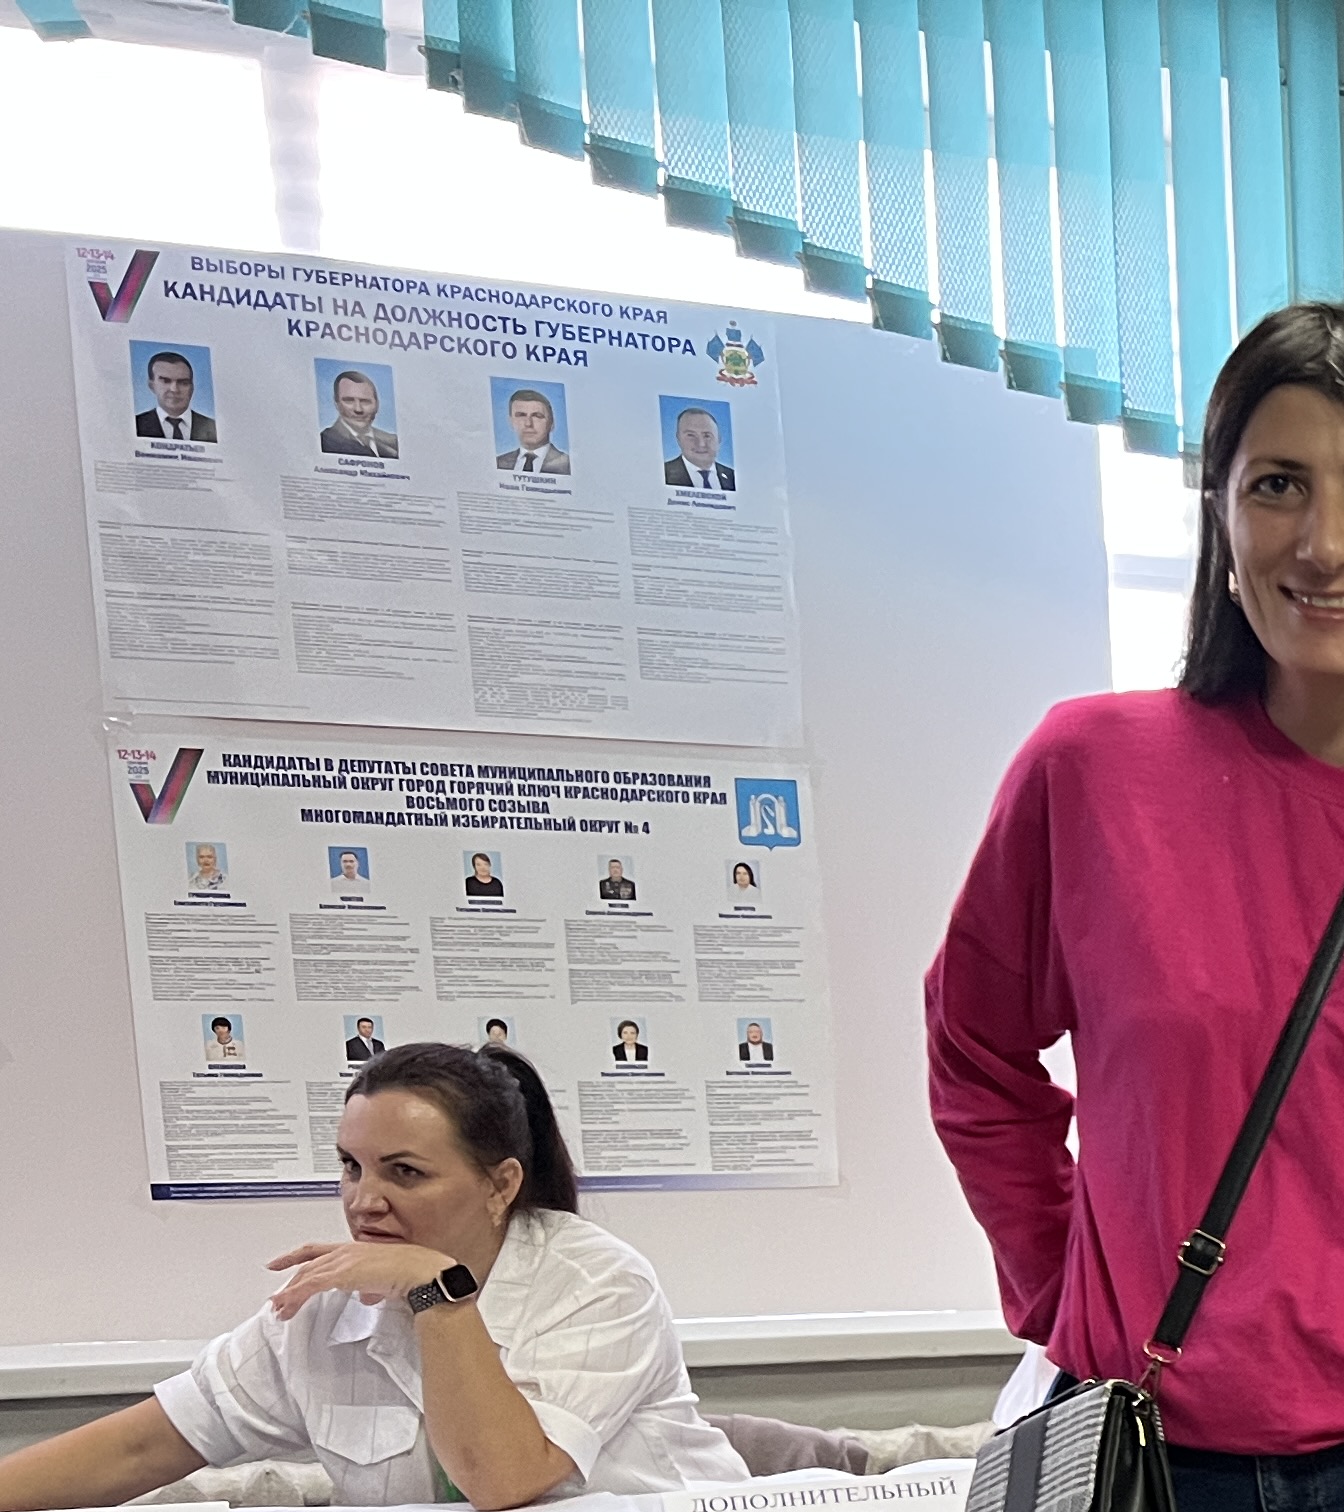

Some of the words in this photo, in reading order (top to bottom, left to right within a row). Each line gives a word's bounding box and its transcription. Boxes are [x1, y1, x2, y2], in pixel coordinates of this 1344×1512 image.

[191, 256, 285, 281] ВЫБОРЫ
[293, 267, 430, 297] ГУБЕРНАТОРА
[437, 283, 613, 317] КРАСНОДАРСКОГО
[619, 305, 668, 325] КРАЯ
[164, 280, 323, 314] КАНДИДАТЫ
[333, 298, 366, 318] НА
[374, 302, 527, 335] ДОЛЖНОСТЬ
[535, 319, 697, 356] ГУБЕРНАТОРА
[287, 318, 517, 359] КРАСНОДАРСКОГО
[526, 344, 588, 367] КРАЯ
[207, 770, 346, 790] МУНИЦИПАЛЬНЫЙ
[351, 775, 394, 791] ОКРУГ
[398, 777, 446, 796] ГОРОД
[450, 779, 514, 797] ГОРЯЧИЙ
[518, 783, 560, 799] КЛЮЧ
[564, 786, 690, 804] КРАСНОДАРСКОГО
[693, 792, 727, 805] КРАЯ
[222, 753, 320, 771] КАНДИДАТЫ
[324, 758, 334, 772] В
[337, 758, 417, 776] ДЕПУТАТЫ
[420, 762, 475, 779] СОВЕТА
[477, 764, 610, 784] МУНИЦИПАЛЬНОГО
[613, 771, 711, 788] ОБРАЗОВАНИЯ
[301, 809, 448, 827] МНОГОМАНДАТНЫЙ
[452, 815, 576, 832] ИЗБИРАТЕЛЬНЫЙ
[579, 819, 621, 834] ОКРУГ
[624, 820, 639, 834] №
[642, 821, 650, 834] 4
[406, 796, 484, 813] ВОСЬМОГО
[489, 798, 550, 814] СОЗЫВА
